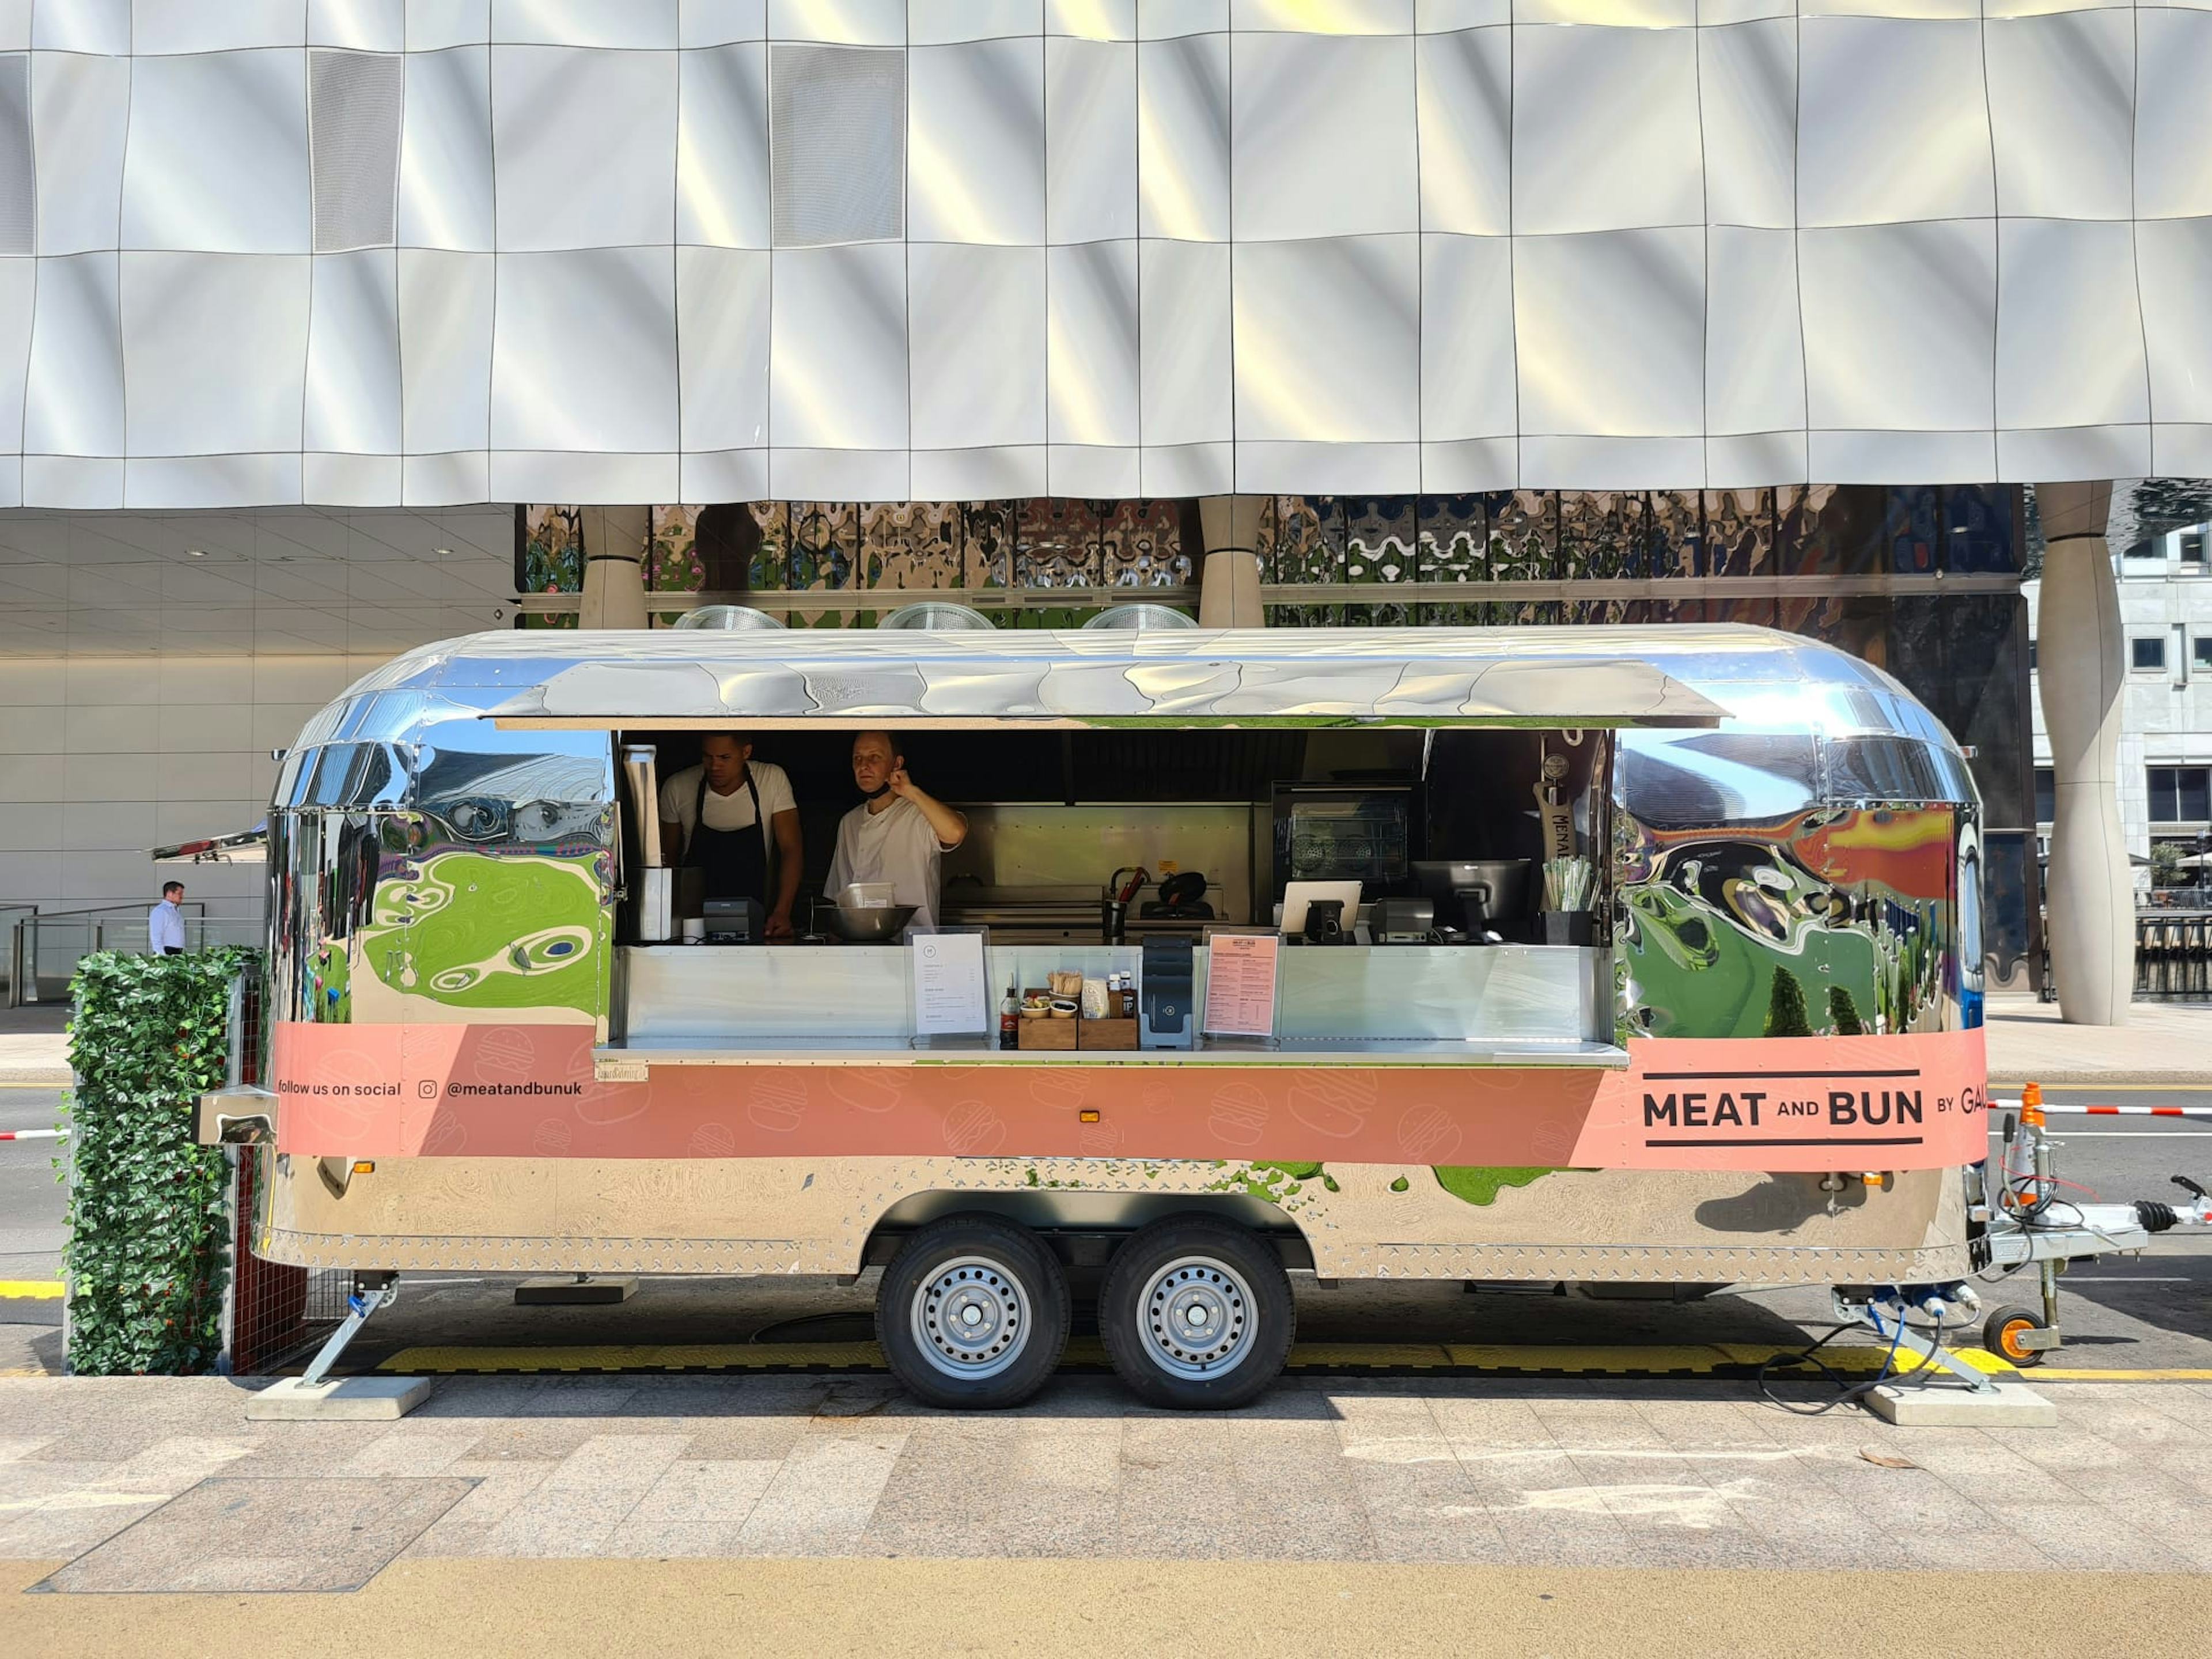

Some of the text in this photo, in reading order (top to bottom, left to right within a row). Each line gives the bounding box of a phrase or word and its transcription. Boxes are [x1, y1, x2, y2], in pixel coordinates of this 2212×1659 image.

[278, 1080, 401, 1095] follow us on social
[447, 1082, 582, 1097] @meatandbunuk
[1643, 1092, 1767, 1127] MEAT
[1777, 1101, 1819, 1116] AND
[1828, 1090, 1923, 1125] BUN
[1937, 1097, 1953, 1112] BY
